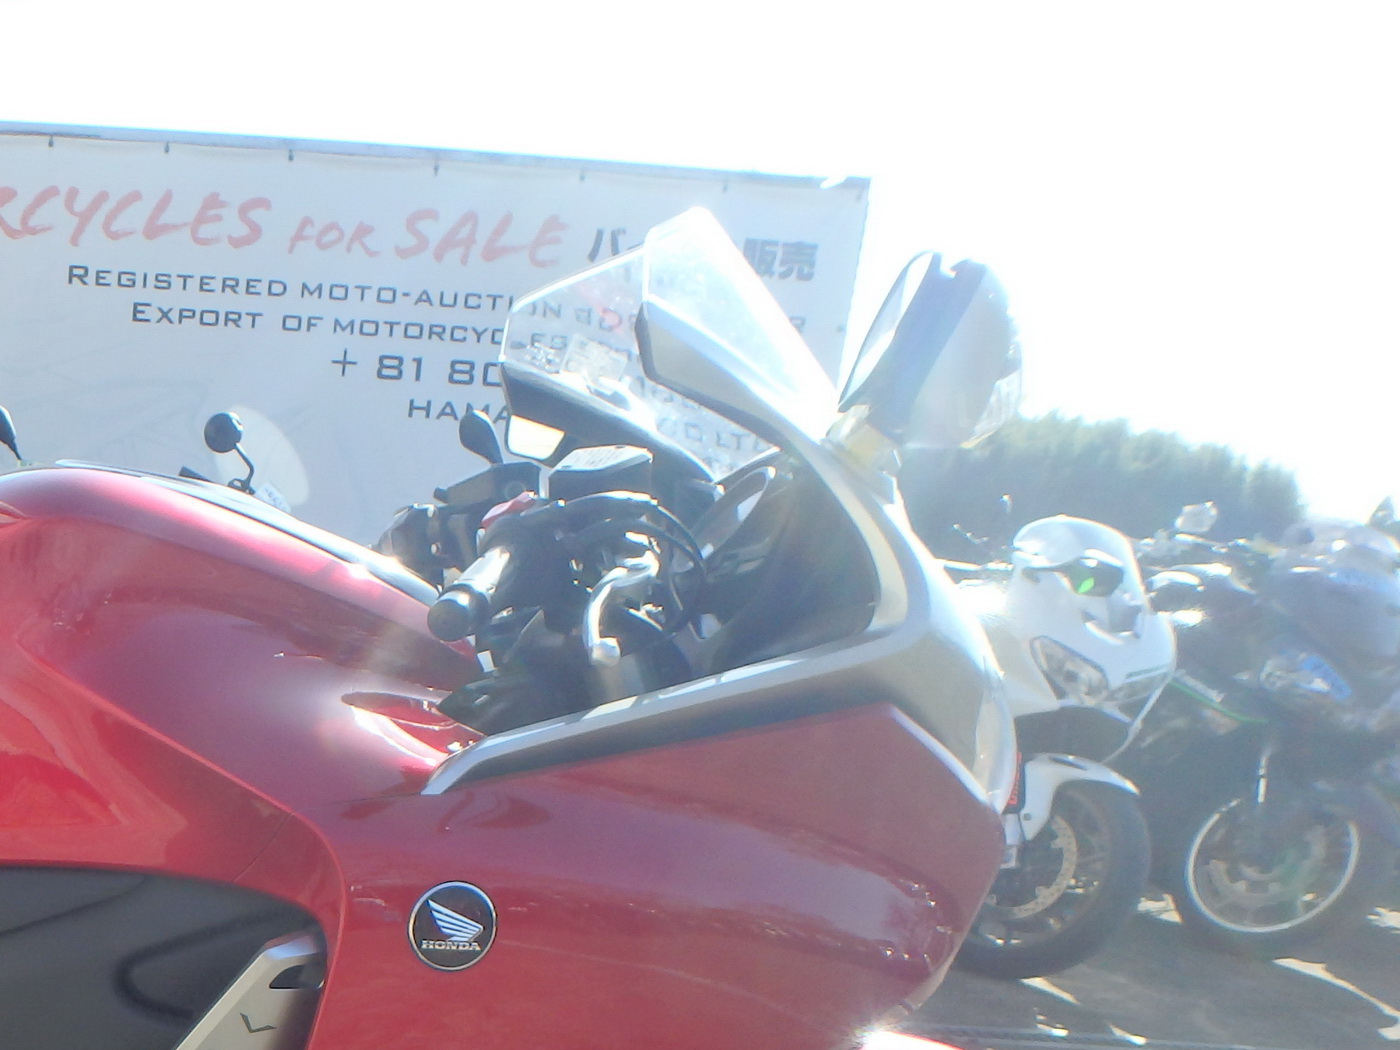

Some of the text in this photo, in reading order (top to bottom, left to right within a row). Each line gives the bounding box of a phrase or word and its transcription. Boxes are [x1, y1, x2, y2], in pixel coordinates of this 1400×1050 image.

[287, 214, 382, 259] FOR
[394, 207, 569, 268] SALE
[281, 315, 324, 333] OF
[376, 354, 422, 382] 81
[420, 939, 483, 951] HONDA
